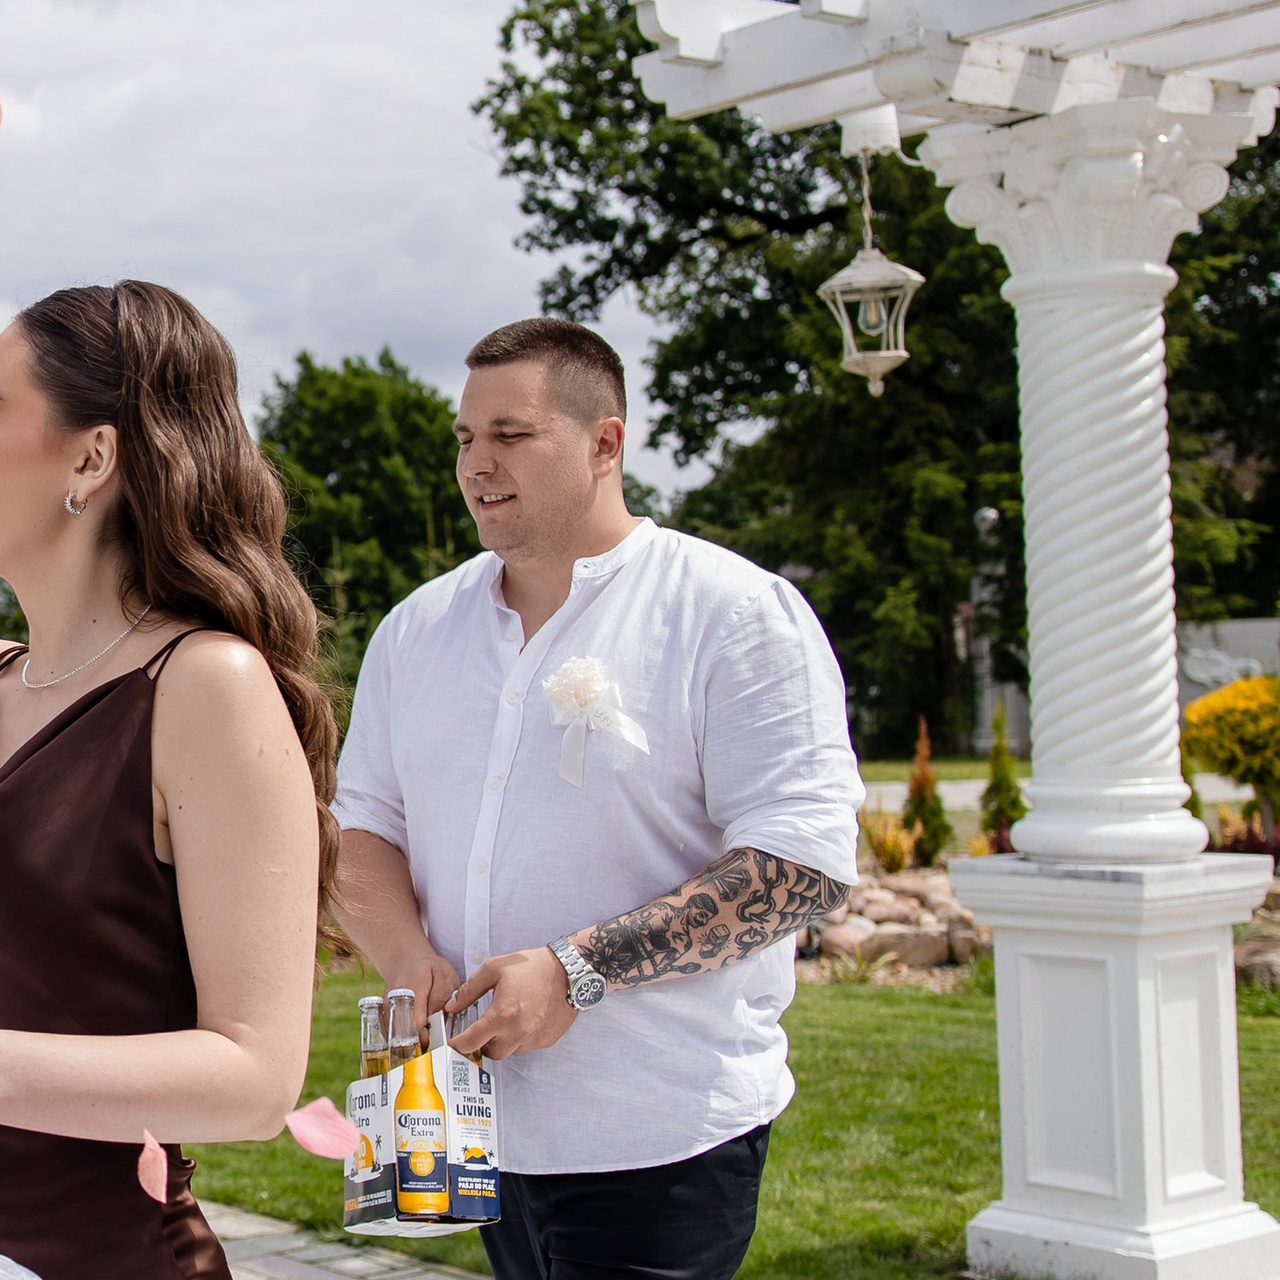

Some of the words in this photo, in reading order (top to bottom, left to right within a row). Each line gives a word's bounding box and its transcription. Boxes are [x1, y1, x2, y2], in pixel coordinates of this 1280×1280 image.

[482, 1073, 488, 1084] 6
[463, 1096, 477, 1104] THIS
[456, 1104, 491, 1118] LIVING
[398, 1113, 441, 1129] Corona
[457, 1117, 475, 1125] SINCE
[411, 1127, 434, 1136] Extra
